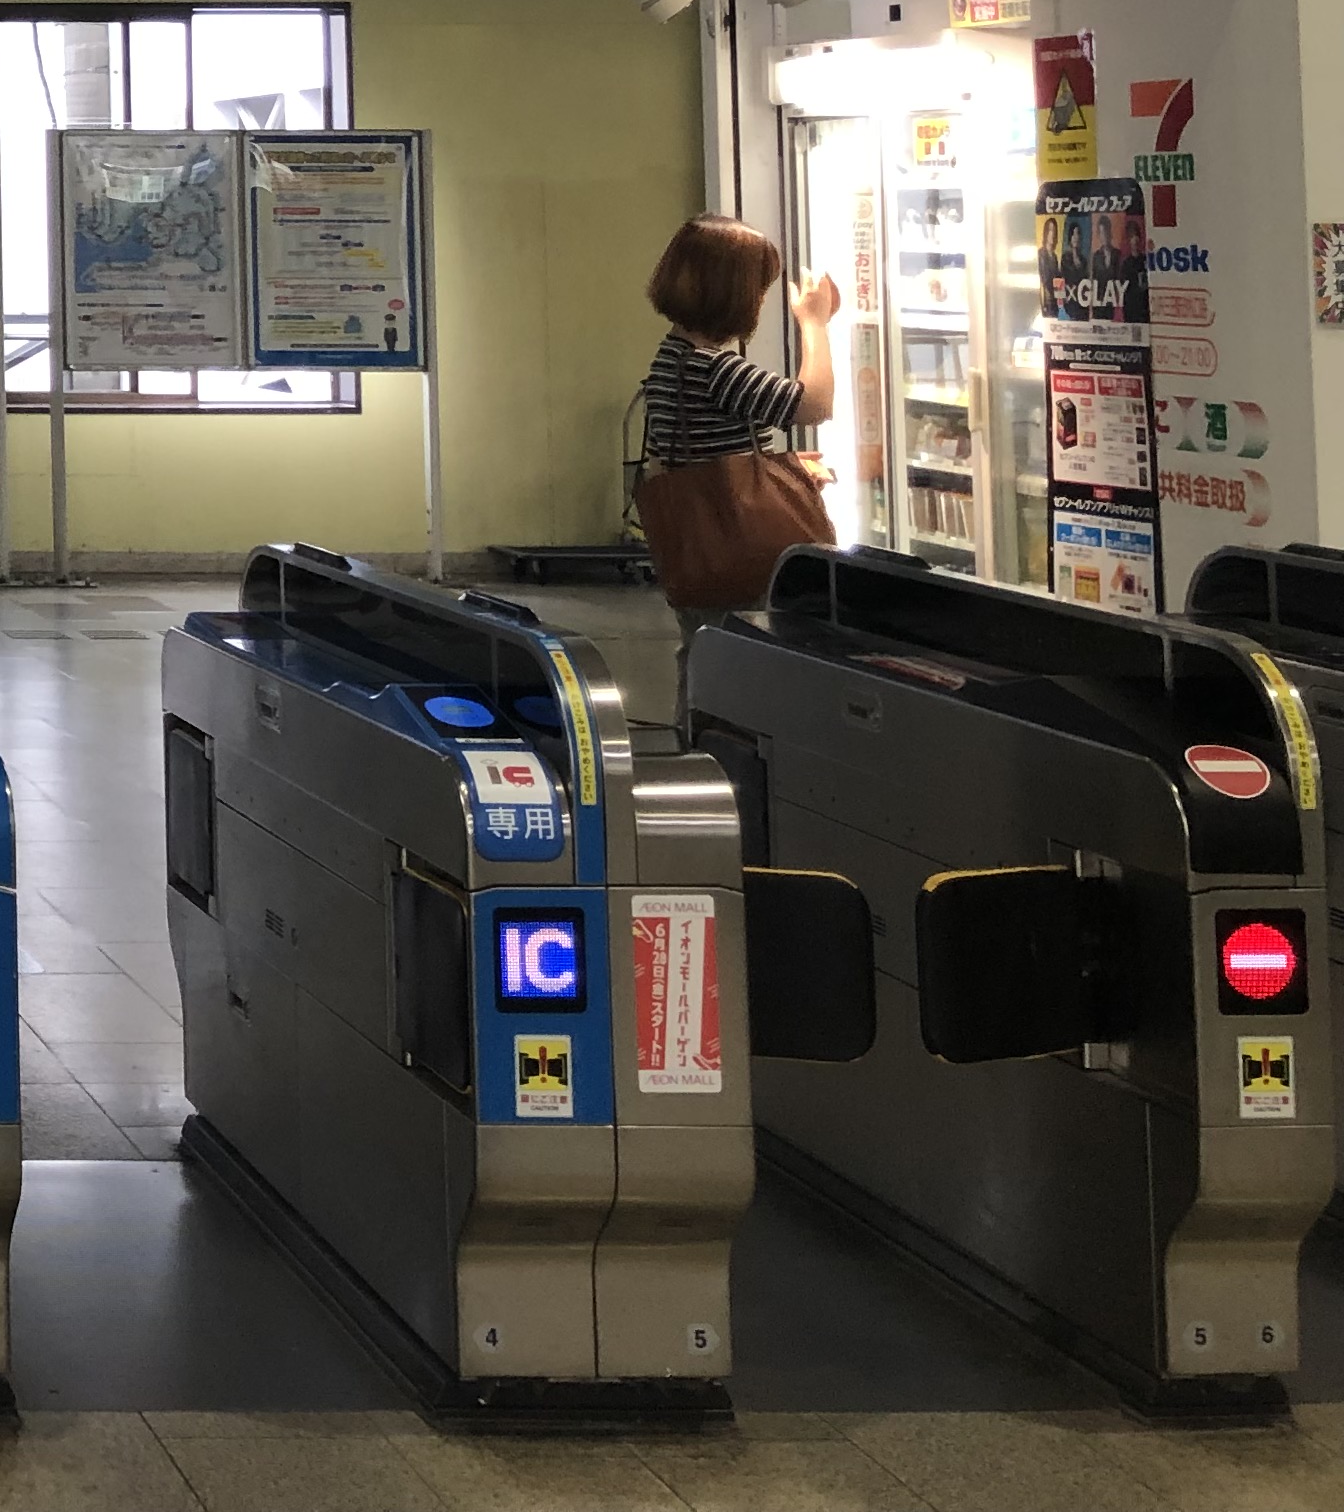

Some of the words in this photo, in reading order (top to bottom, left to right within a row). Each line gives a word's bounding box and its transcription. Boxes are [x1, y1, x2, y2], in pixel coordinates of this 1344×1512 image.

[1147, 239, 1210, 273] iosk
[1158, 471, 1247, 514] 共料金取扱
[485, 806, 555, 840] 専用
[673, 902, 707, 913] MALL
[505, 928, 576, 993] IC
[681, 1074, 716, 1086] MALL
[486, 1327, 498, 1347] 4
[695, 1329, 707, 1348] 5
[1194, 1327, 1206, 1345] 5
[1262, 1325, 1273, 1344] 6
